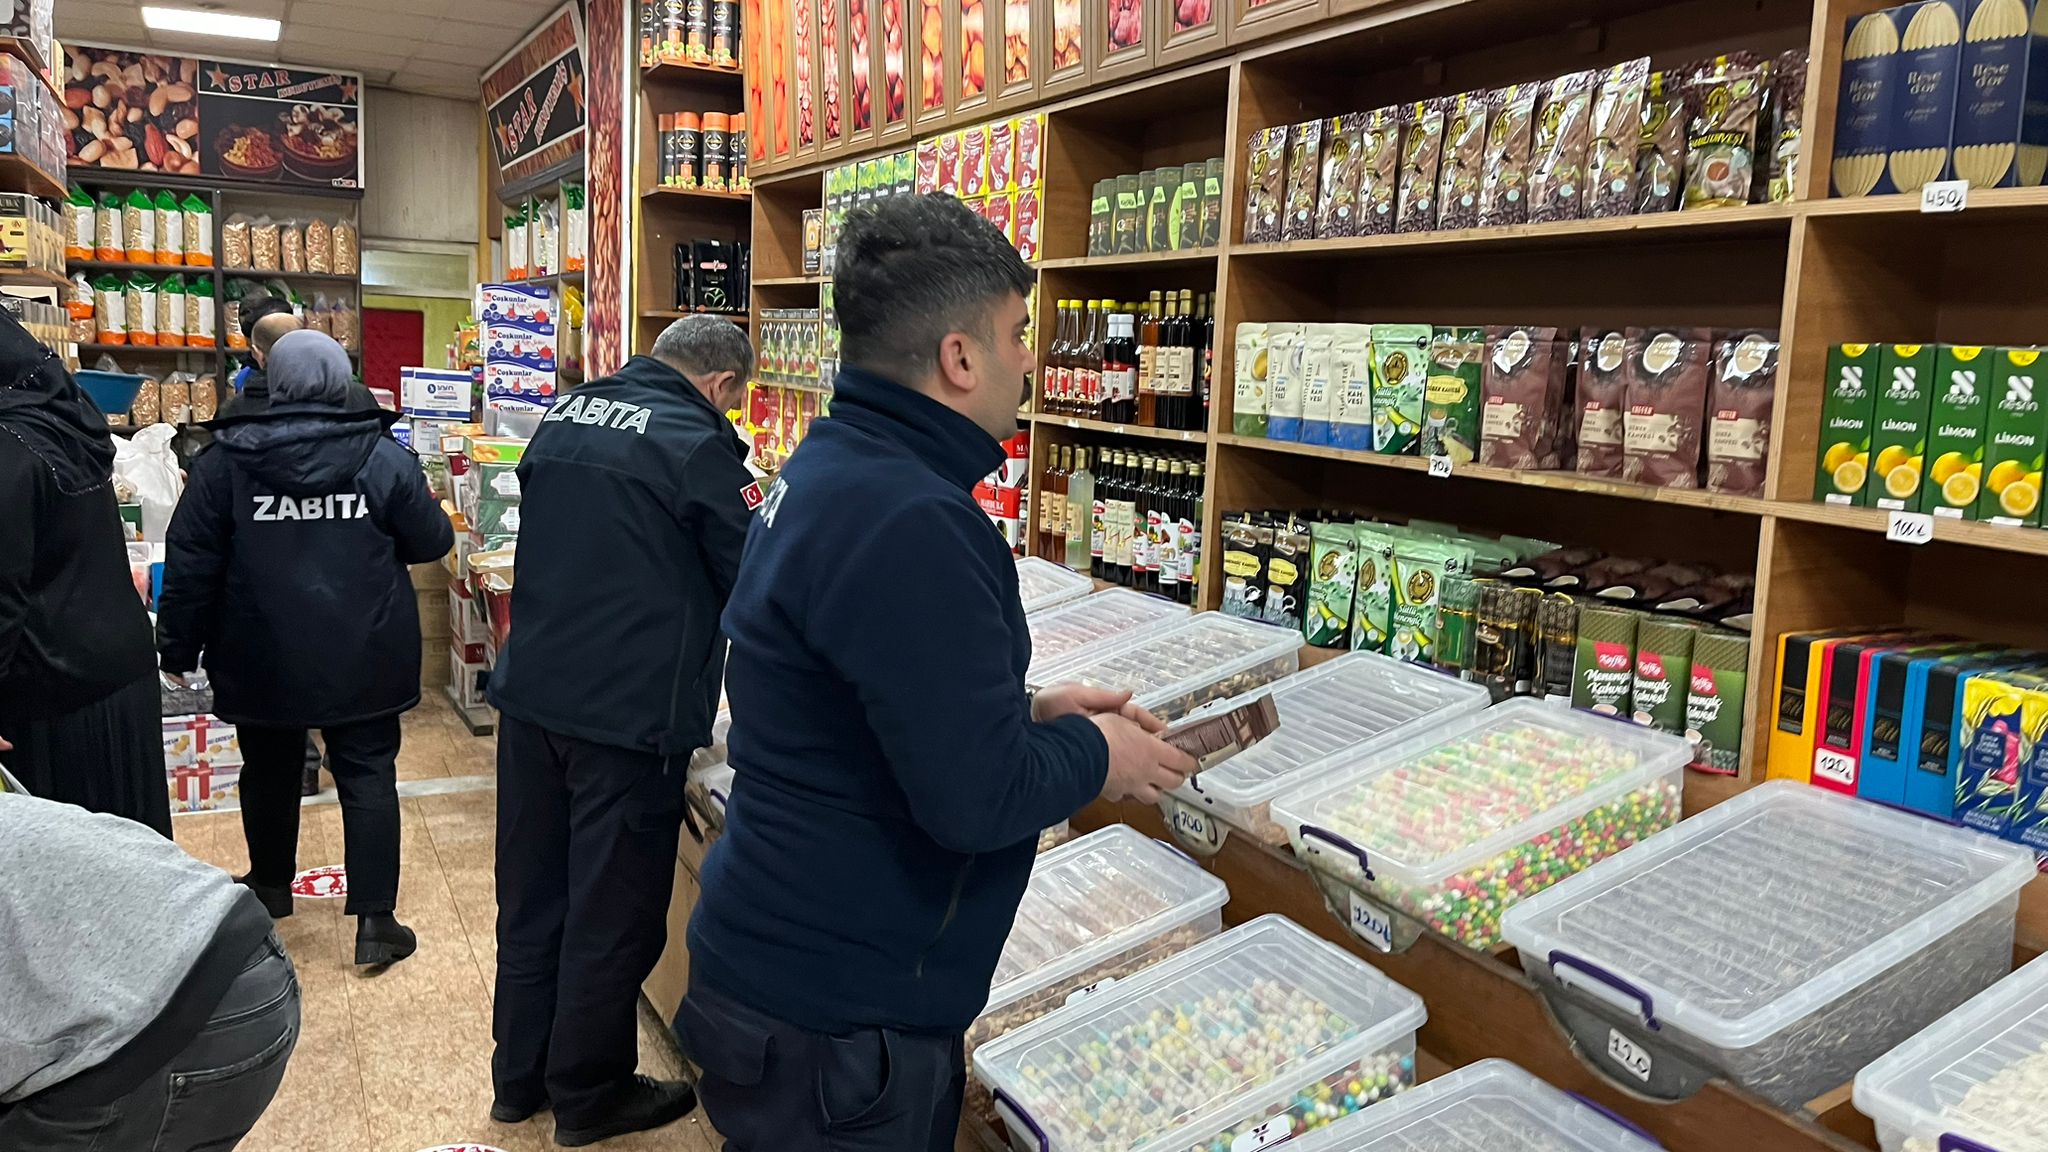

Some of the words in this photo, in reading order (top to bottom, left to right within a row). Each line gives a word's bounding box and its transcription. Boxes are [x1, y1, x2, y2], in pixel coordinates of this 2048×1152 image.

[229, 69, 291, 93] STAR
[508, 87, 537, 155] STAR
[544, 394, 653, 436] ZABITA
[1830, 417, 1863, 429] LİMON
[1881, 418, 1917, 432] LİMON
[1938, 424, 1977, 438] LİMON
[1994, 431, 2035, 446] LİMON
